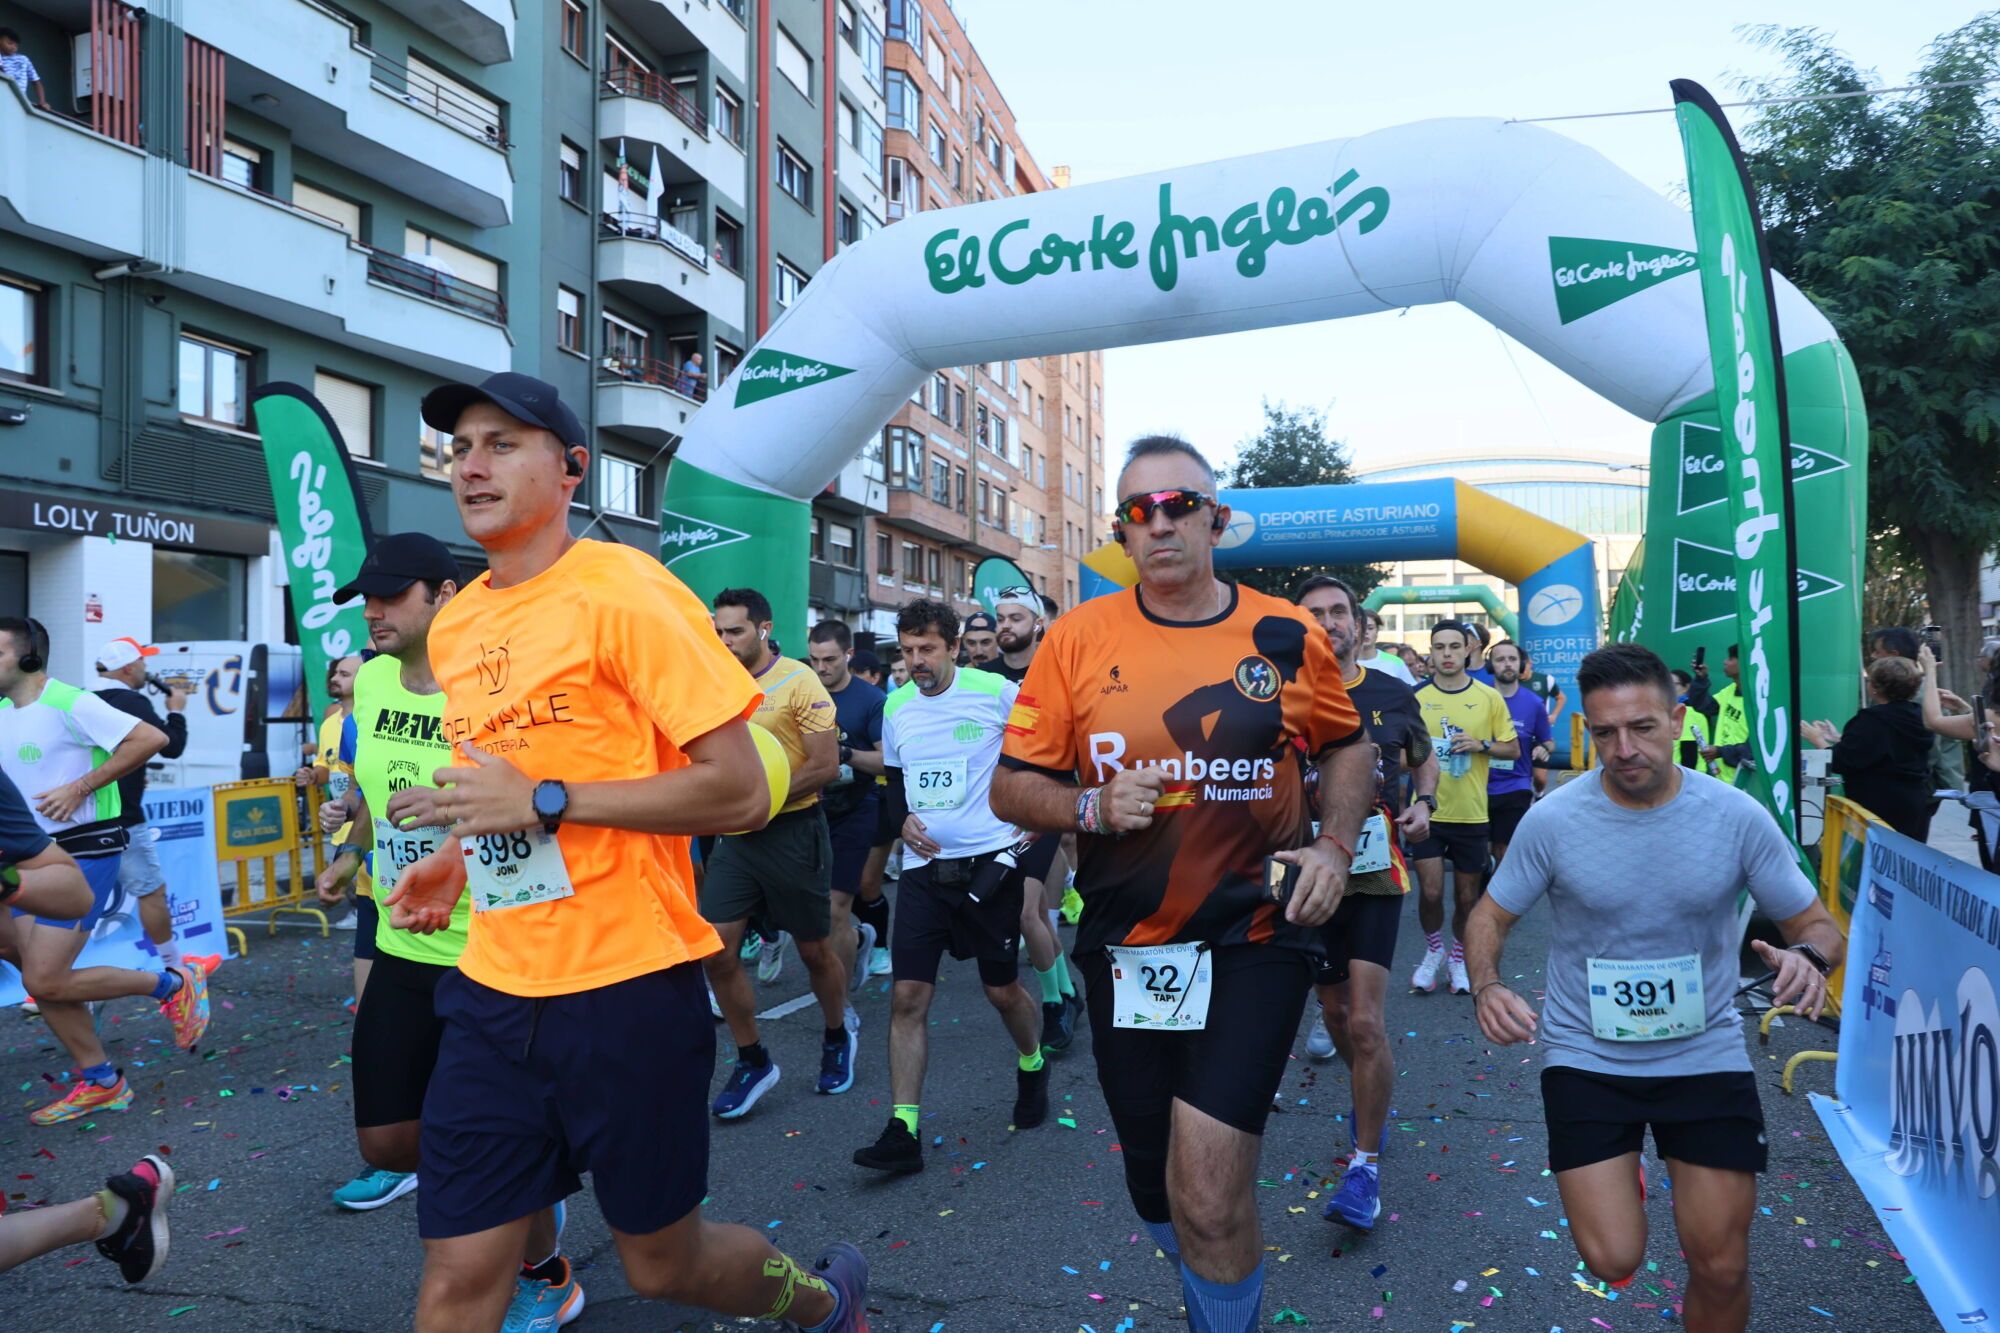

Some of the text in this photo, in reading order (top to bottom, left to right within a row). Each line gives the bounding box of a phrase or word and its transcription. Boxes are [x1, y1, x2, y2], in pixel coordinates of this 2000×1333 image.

[924, 167, 1390, 294] El Corte Inglés
[1555, 251, 1696, 287] El Corte Inglés
[752, 365, 780, 380] Corte
[1685, 456, 1701, 474] El
[34, 503, 195, 544] LOLY TUÑON
[1260, 503, 1441, 527] DEPORTE ASTURIANO
[1678, 574, 1695, 592] El
[1525, 638, 1594, 651] DEPORTE
[919, 771, 953, 788] 573
[1204, 784, 1273, 801] Numancia
[145, 799, 204, 820] VIEDO
[387, 838, 435, 863] 1:55
[475, 829, 531, 866] 398
[496, 864, 518, 877] JONI
[1946, 881, 1988, 940] VERDE
[1165, 947, 1176, 955] DE
[1141, 965, 1182, 993] 22
[1153, 993, 1176, 1003] TAPI
[1614, 978, 1676, 1007] 391
[1629, 1007, 1668, 1017] ANGEL
